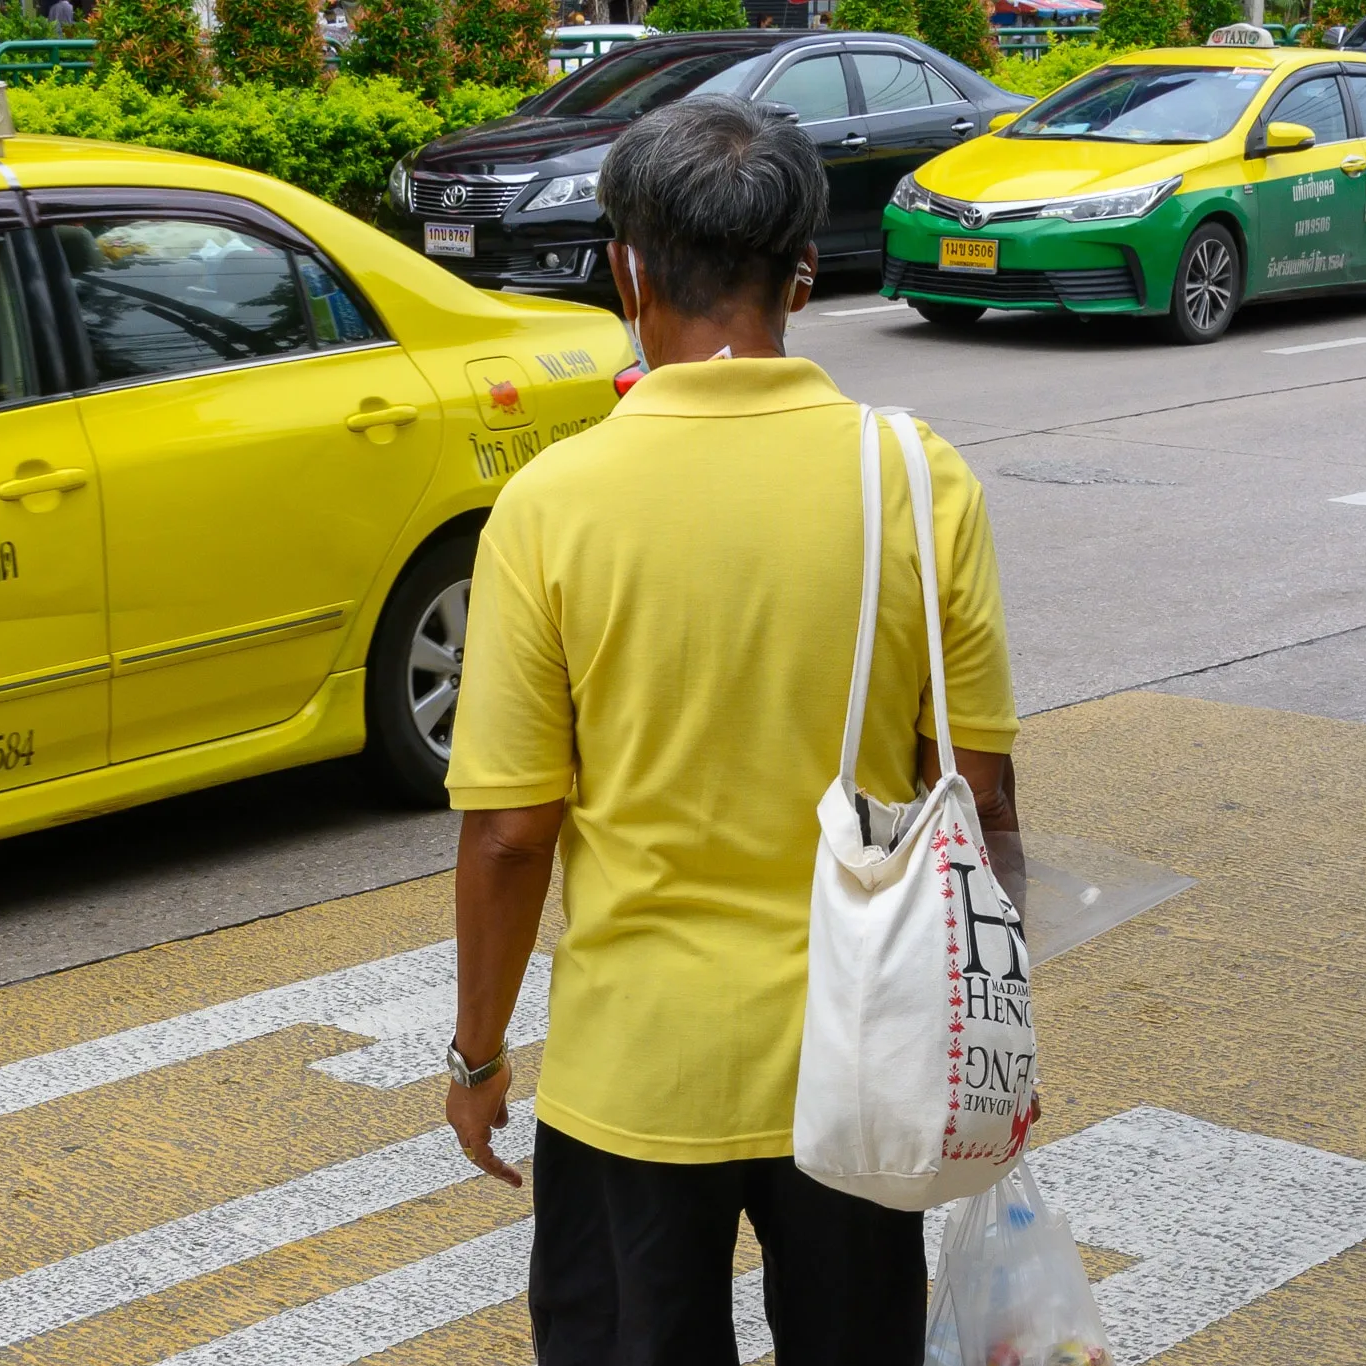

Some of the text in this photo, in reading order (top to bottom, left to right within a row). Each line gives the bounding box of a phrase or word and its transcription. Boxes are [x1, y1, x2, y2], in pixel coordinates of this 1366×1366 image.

[1225, 30, 1248, 44] TAXI
[448, 229, 470, 243] 8787
[968, 243, 994, 258] 9506
[992, 979, 1031, 999] MADAM
[965, 1044, 1035, 1094] ENG
[962, 1092, 1014, 1116] ADAME
